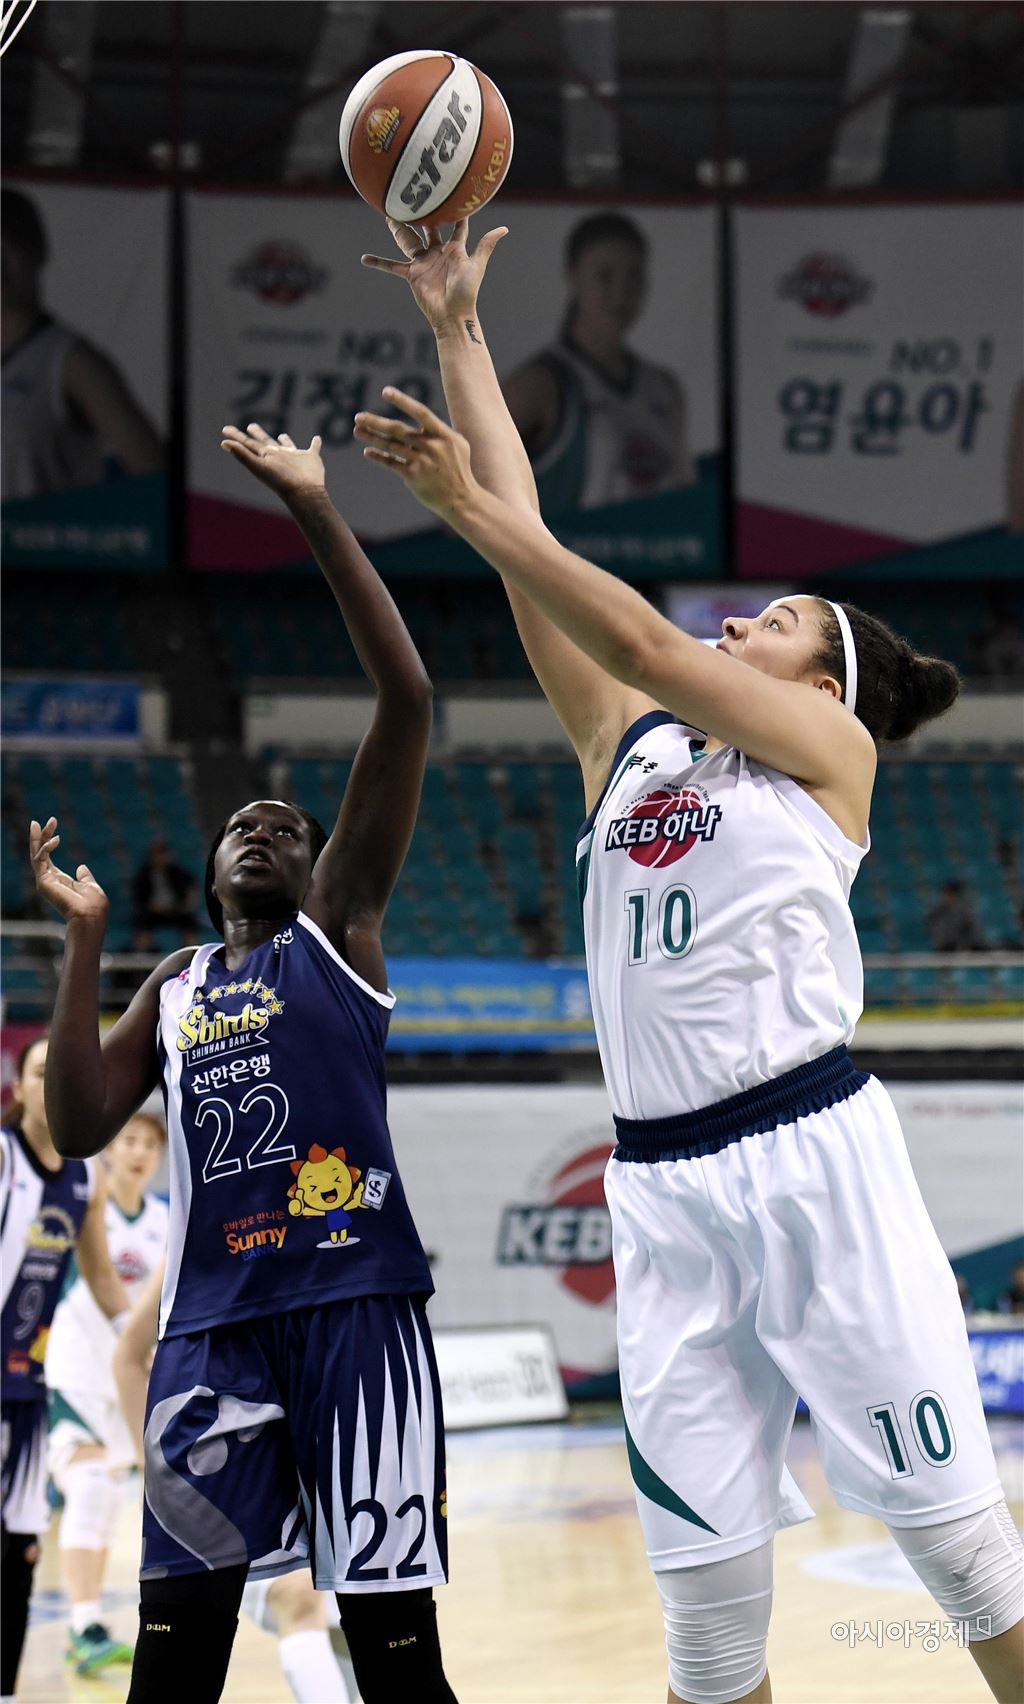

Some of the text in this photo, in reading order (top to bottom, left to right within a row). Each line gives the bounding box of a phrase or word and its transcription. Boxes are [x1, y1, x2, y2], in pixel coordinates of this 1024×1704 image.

[778, 376, 991, 456] 염윤아
[606, 805, 720, 848] KEB 하나
[623, 882, 699, 967] 10
[176, 1004, 269, 1051] Sbirds
[191, 1032, 252, 1060] SHINHAN BANK
[191, 1053, 271, 1095] 신한은행
[194, 1083, 297, 1184] 22
[226, 1226, 288, 1254] Sunny
[243, 1244, 277, 1260] BANK
[504, 1208, 613, 1262] KEB
[13, 1282, 46, 1341] 9
[866, 1389, 957, 1480] 10
[344, 1494, 428, 1582] 22
